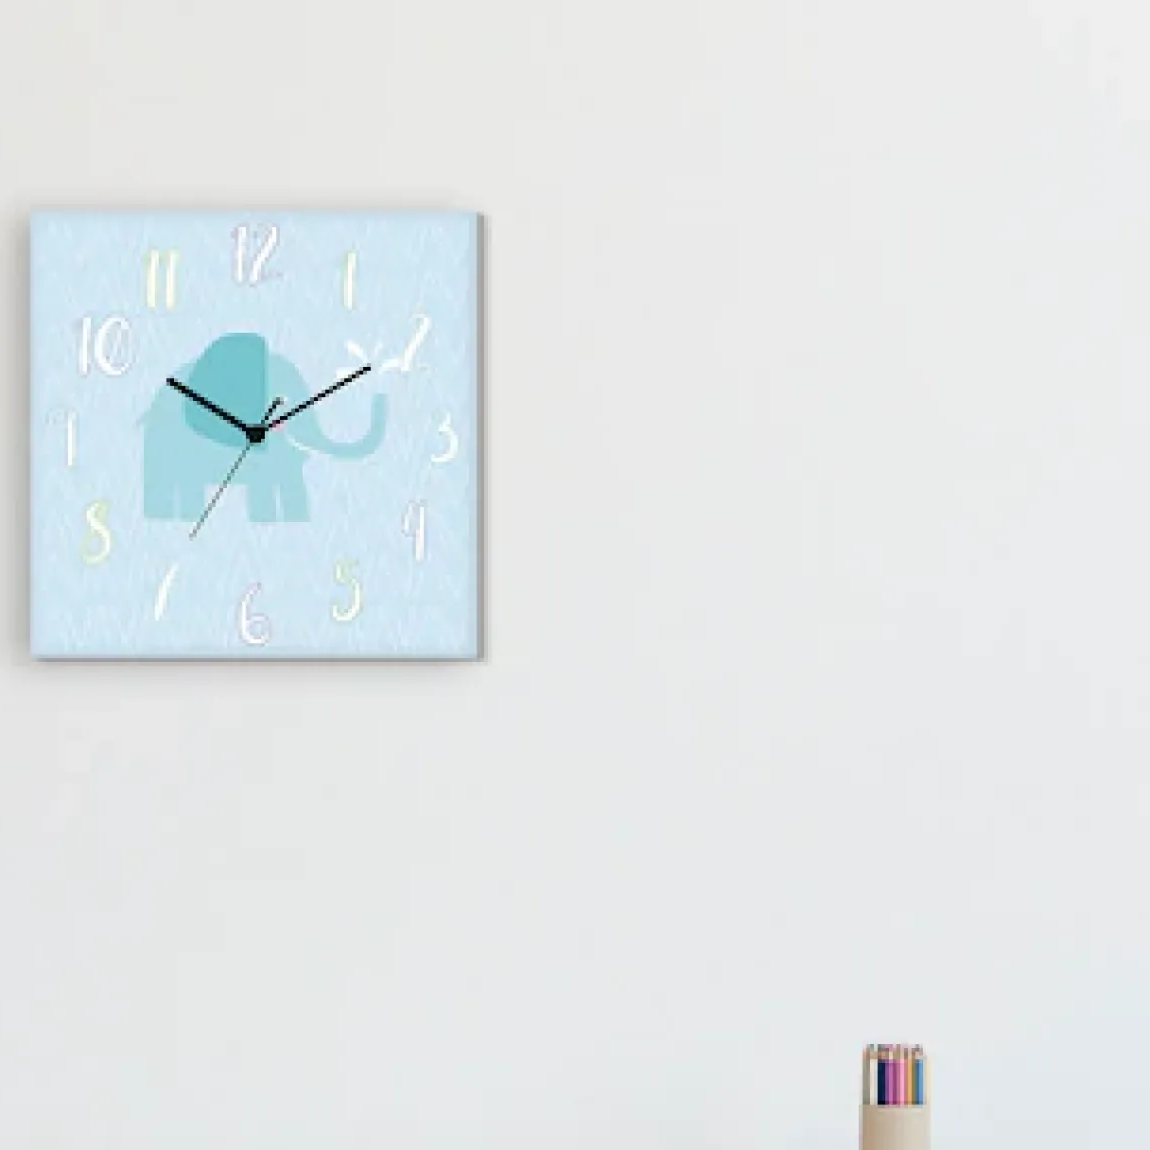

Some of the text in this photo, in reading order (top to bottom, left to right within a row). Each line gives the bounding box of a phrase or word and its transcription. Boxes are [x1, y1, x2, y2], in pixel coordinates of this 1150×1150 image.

[144, 247, 181, 311] 11
[230, 222, 283, 286] 12
[342, 248, 360, 311] 1
[76, 313, 135, 376] 10
[237, 581, 273, 648] 6
[330, 556, 366, 624] 5
